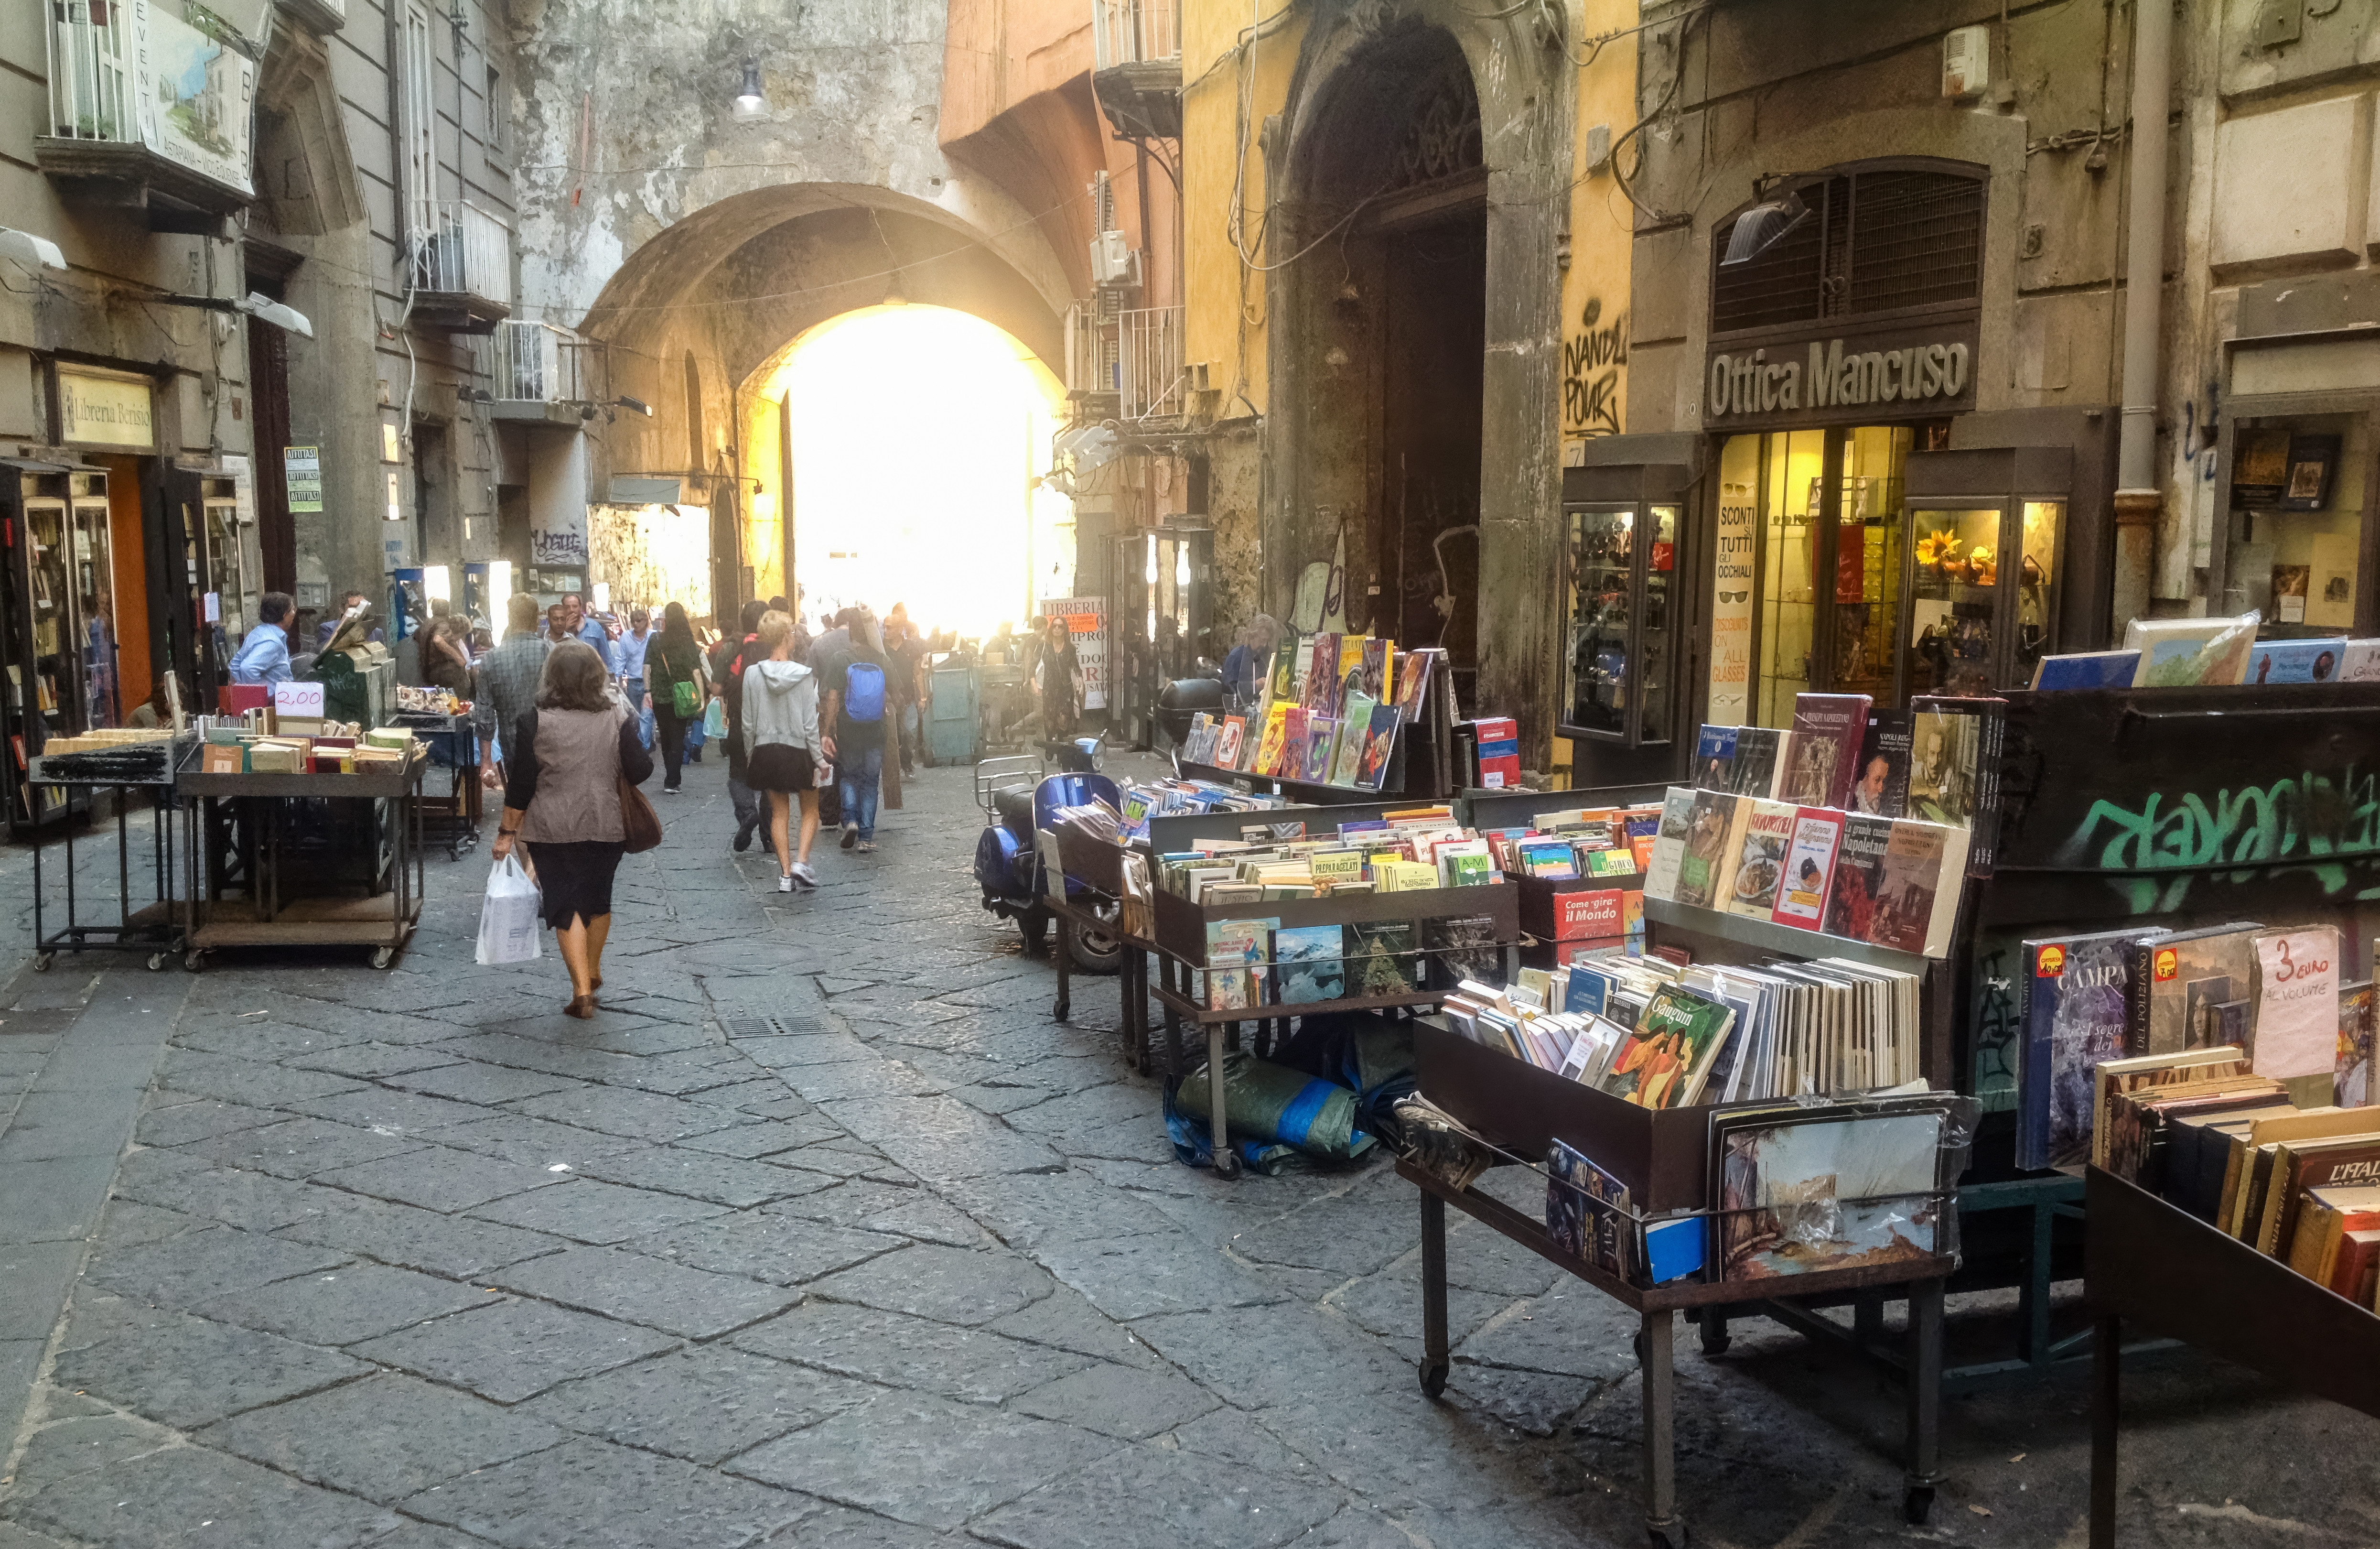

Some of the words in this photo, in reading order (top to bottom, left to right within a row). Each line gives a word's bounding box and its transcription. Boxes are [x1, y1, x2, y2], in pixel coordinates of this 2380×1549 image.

[1711, 349, 1800, 416] Ottica
[1807, 339, 1968, 407] Mancuso
[74, 397, 115, 423] Libreria
[1721, 506, 1755, 525] SCONTI
[1721, 536, 1753, 553] TUTTI
[1719, 553, 1731, 563] GLI
[1718, 565, 1752, 578] OCCHIALI
[1044, 601, 1105, 616] LIBRERIA
[1715, 635, 1728, 647] ON
[1723, 650, 1746, 663] ALL
[1712, 665, 1746, 682] GLASSES
[277, 691, 321, 706] 2,00
[1565, 901, 1589, 909] Come
[1565, 910, 1574, 922] il
[1575, 907, 1616, 921] Mondo
[2275, 939, 2294, 982] 3
[2297, 960, 2328, 979] EURO
[2137, 952, 2148, 1021] POLIZIANO
[2265, 989, 2279, 1001] AL
[2282, 982, 2329, 1001] VOLUME
[1651, 995, 1693, 1027] Gauguin
